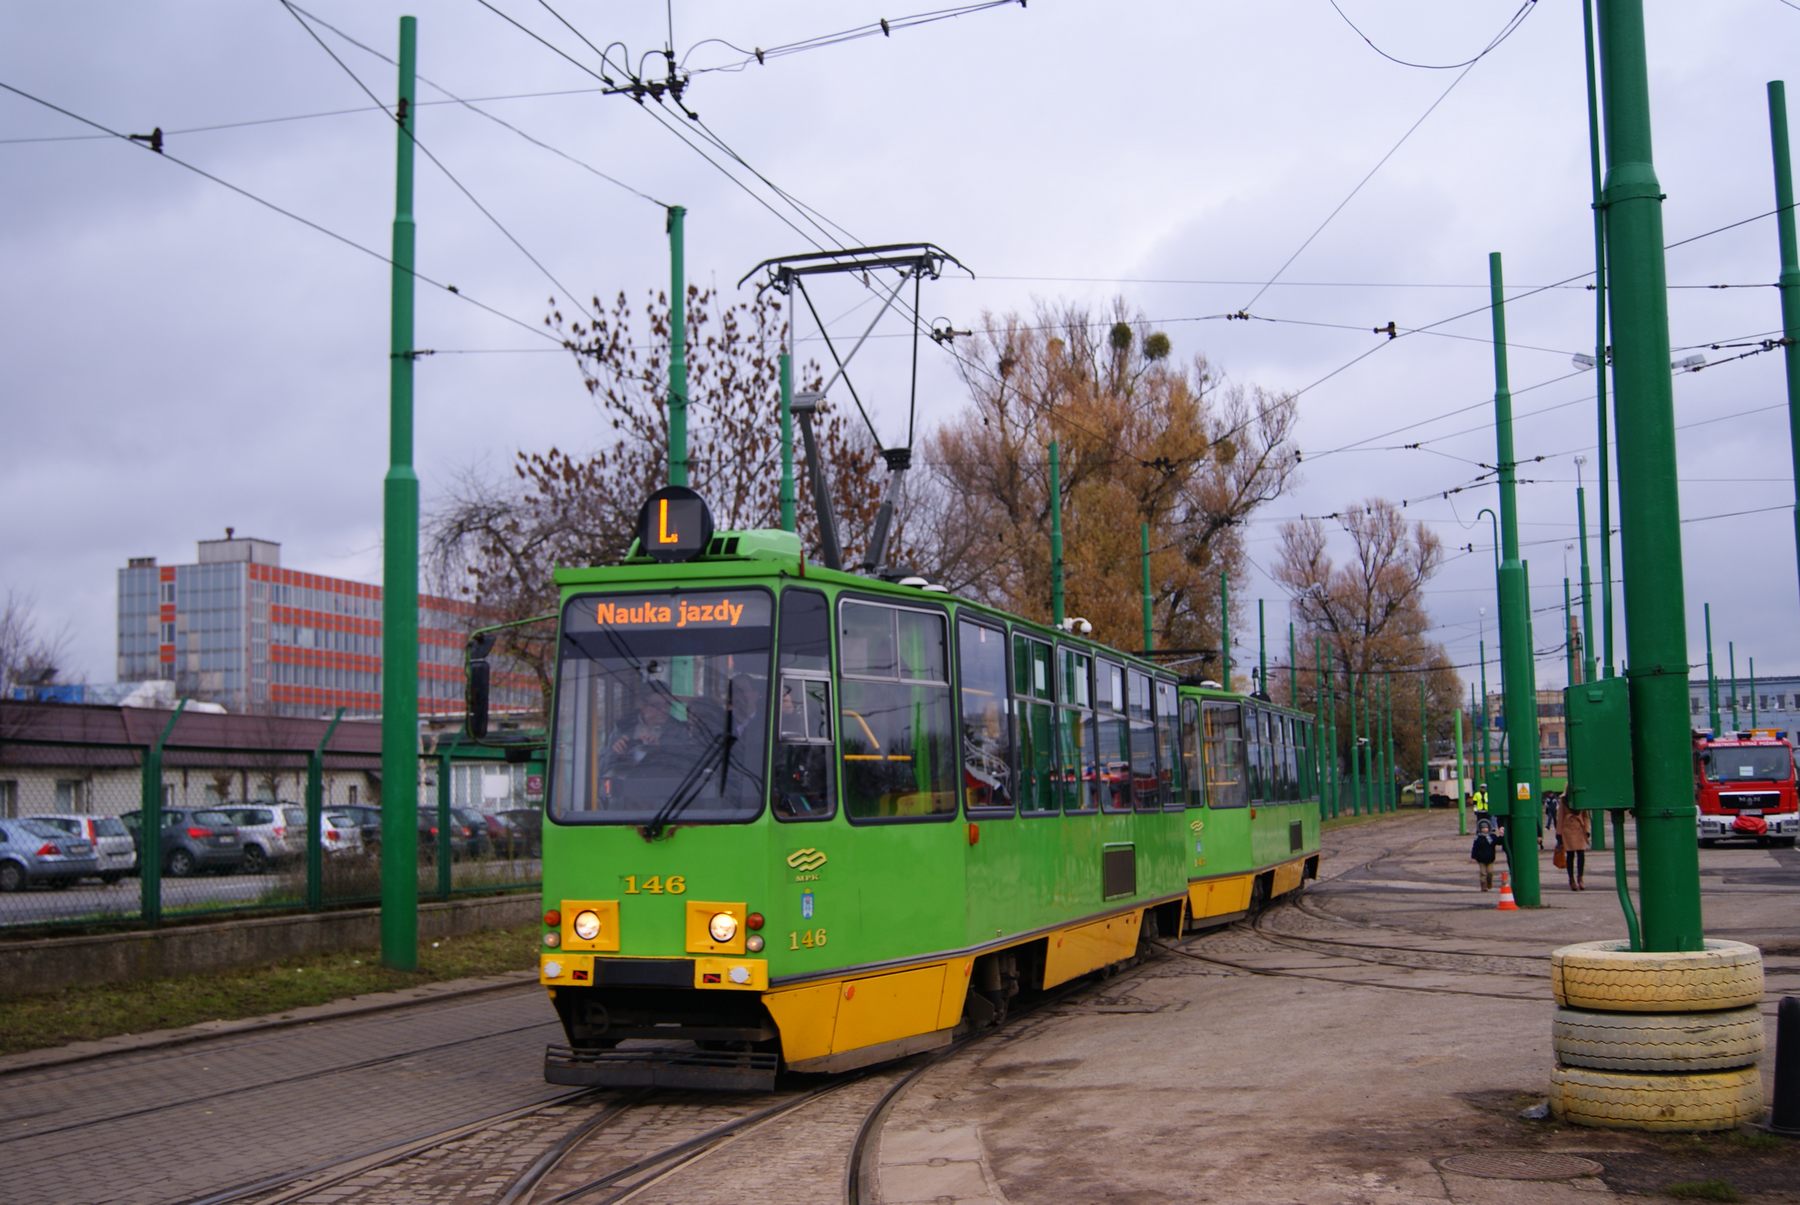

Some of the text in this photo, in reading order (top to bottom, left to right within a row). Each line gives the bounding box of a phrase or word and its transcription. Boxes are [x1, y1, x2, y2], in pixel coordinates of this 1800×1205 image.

[597, 599, 744, 628] Nauka jazdy
[624, 875, 687, 895] 146
[795, 874, 819, 883] MPK
[789, 928, 828, 951] 146
